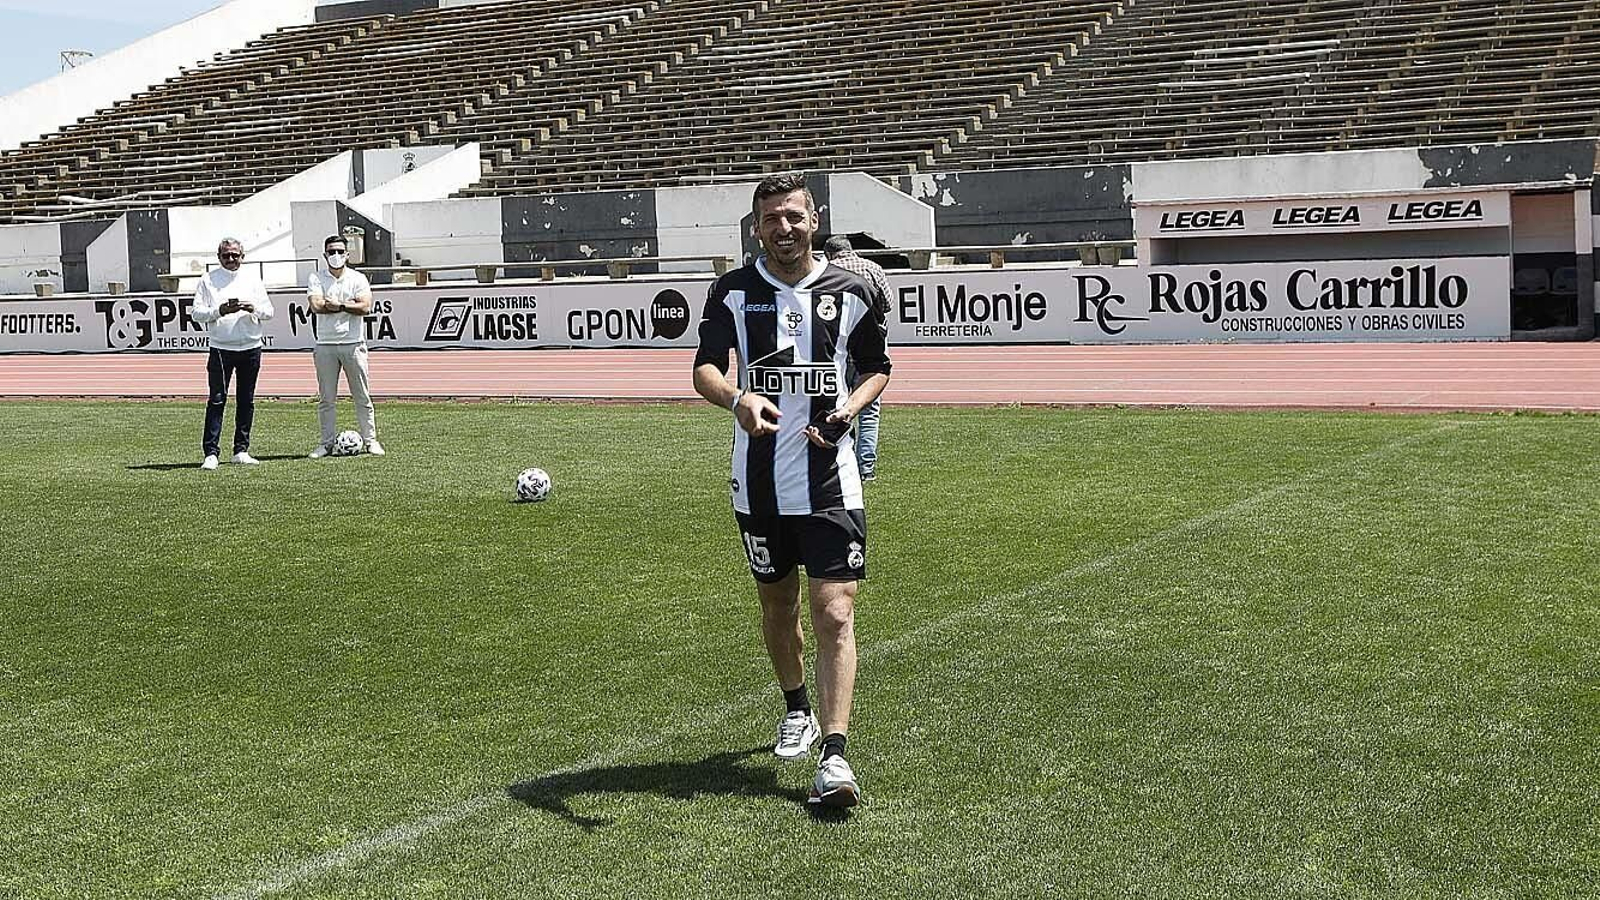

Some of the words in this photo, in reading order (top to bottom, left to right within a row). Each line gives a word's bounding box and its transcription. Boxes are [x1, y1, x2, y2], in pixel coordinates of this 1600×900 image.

[1160, 209, 1245, 229] LEGEA
[1273, 206, 1360, 225] LEGEA
[1388, 200, 1482, 220] LEGEA
[473, 296, 536, 310] INDUSTRIAS
[1148, 270, 1267, 323] Rojas
[1286, 265, 1468, 312] Carrillo
[368, 301, 392, 314] AS
[653, 303, 685, 319] linea
[739, 304, 776, 312] LEGEA
[898, 285, 925, 324] El
[937, 284, 1047, 331] Monje
[1, 313, 81, 334] FOOTTERS.
[473, 312, 538, 341] LACSE
[568, 308, 646, 340] GPON
[915, 322, 993, 337] FERRETERÍA
[1221, 316, 1342, 332] CONSTRUCCIONES
[1347, 316, 1357, 330] Y
[1361, 315, 1408, 331] OBRAS
[1412, 314, 1465, 330] CIVILES
[157, 337, 178, 348] THE
[181, 337, 210, 348] POWE
[749, 369, 837, 395] LOTUS
[744, 532, 770, 566] 15
